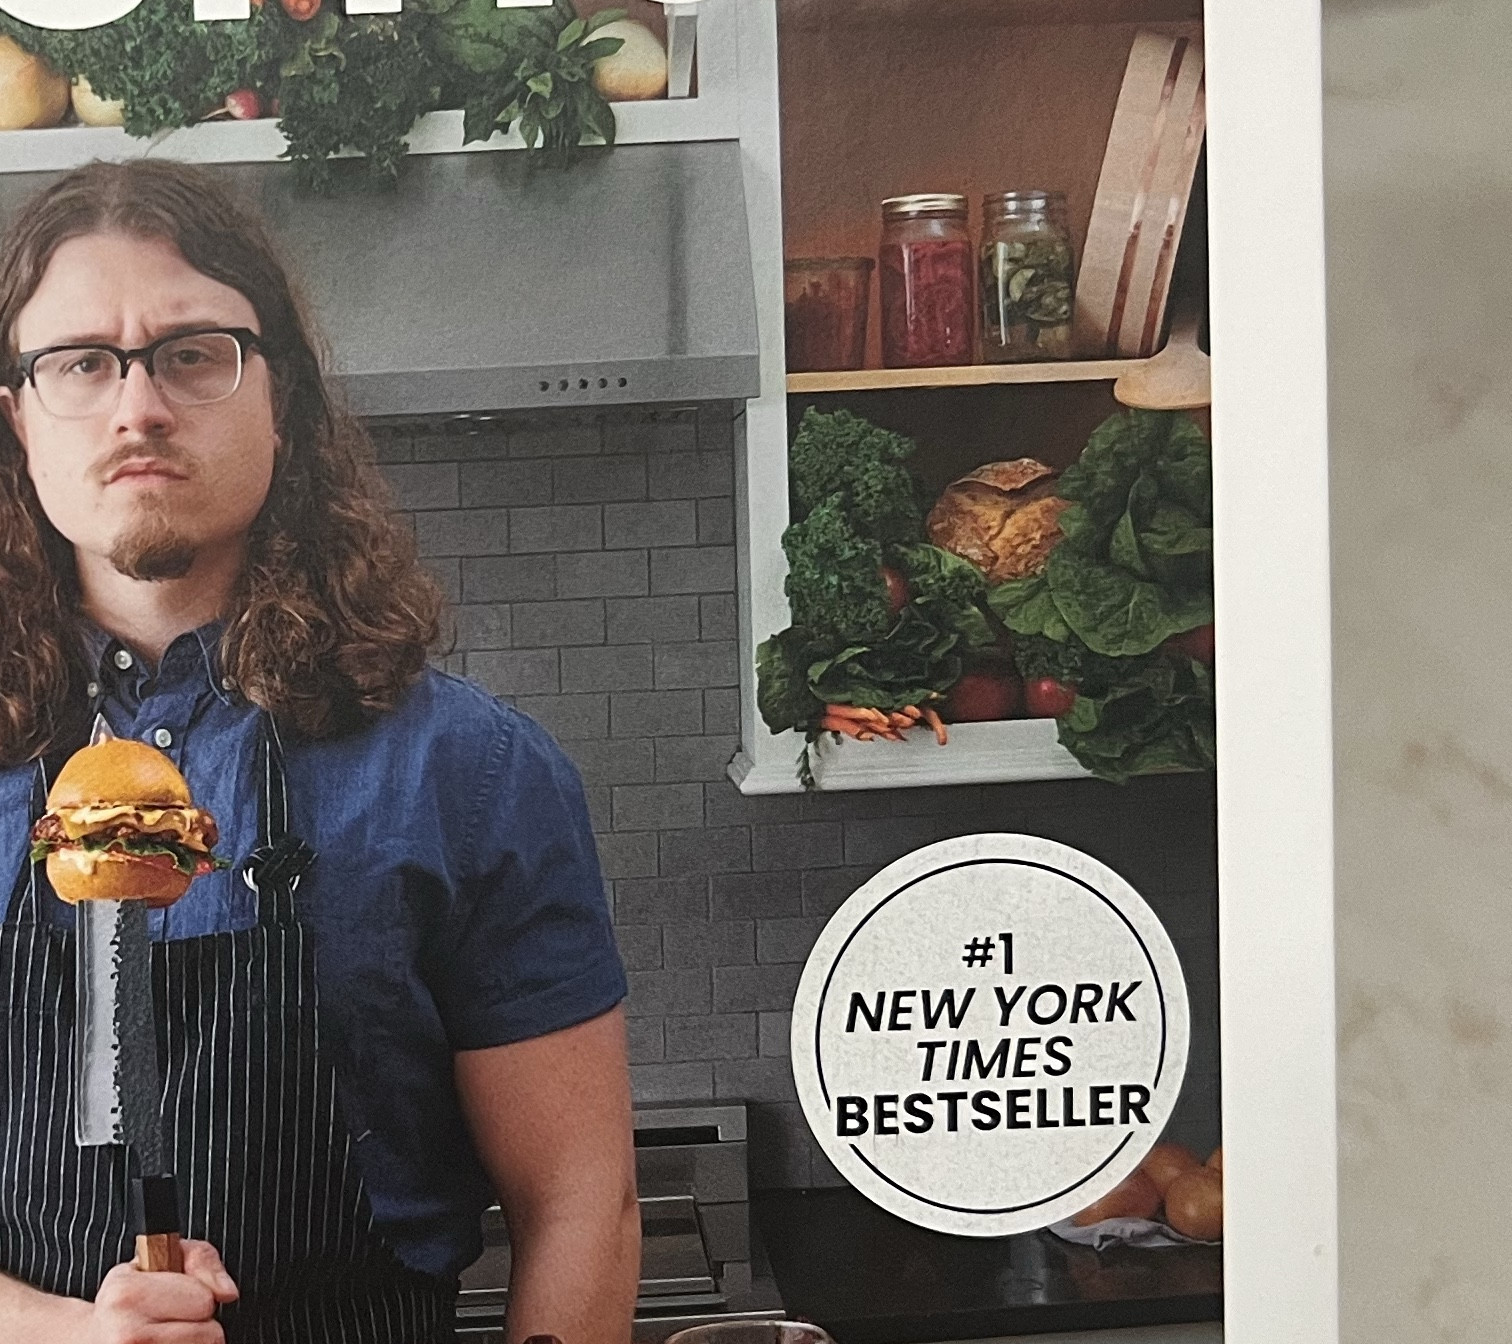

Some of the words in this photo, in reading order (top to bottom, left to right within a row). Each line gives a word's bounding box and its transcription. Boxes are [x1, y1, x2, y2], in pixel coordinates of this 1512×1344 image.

[961, 932, 1014, 975] #1
[844, 987, 977, 1033] NEW
[993, 981, 1143, 1027] YORK
[916, 1035, 1074, 1082] TIMES
[836, 1084, 1151, 1137] BESTSELLER
